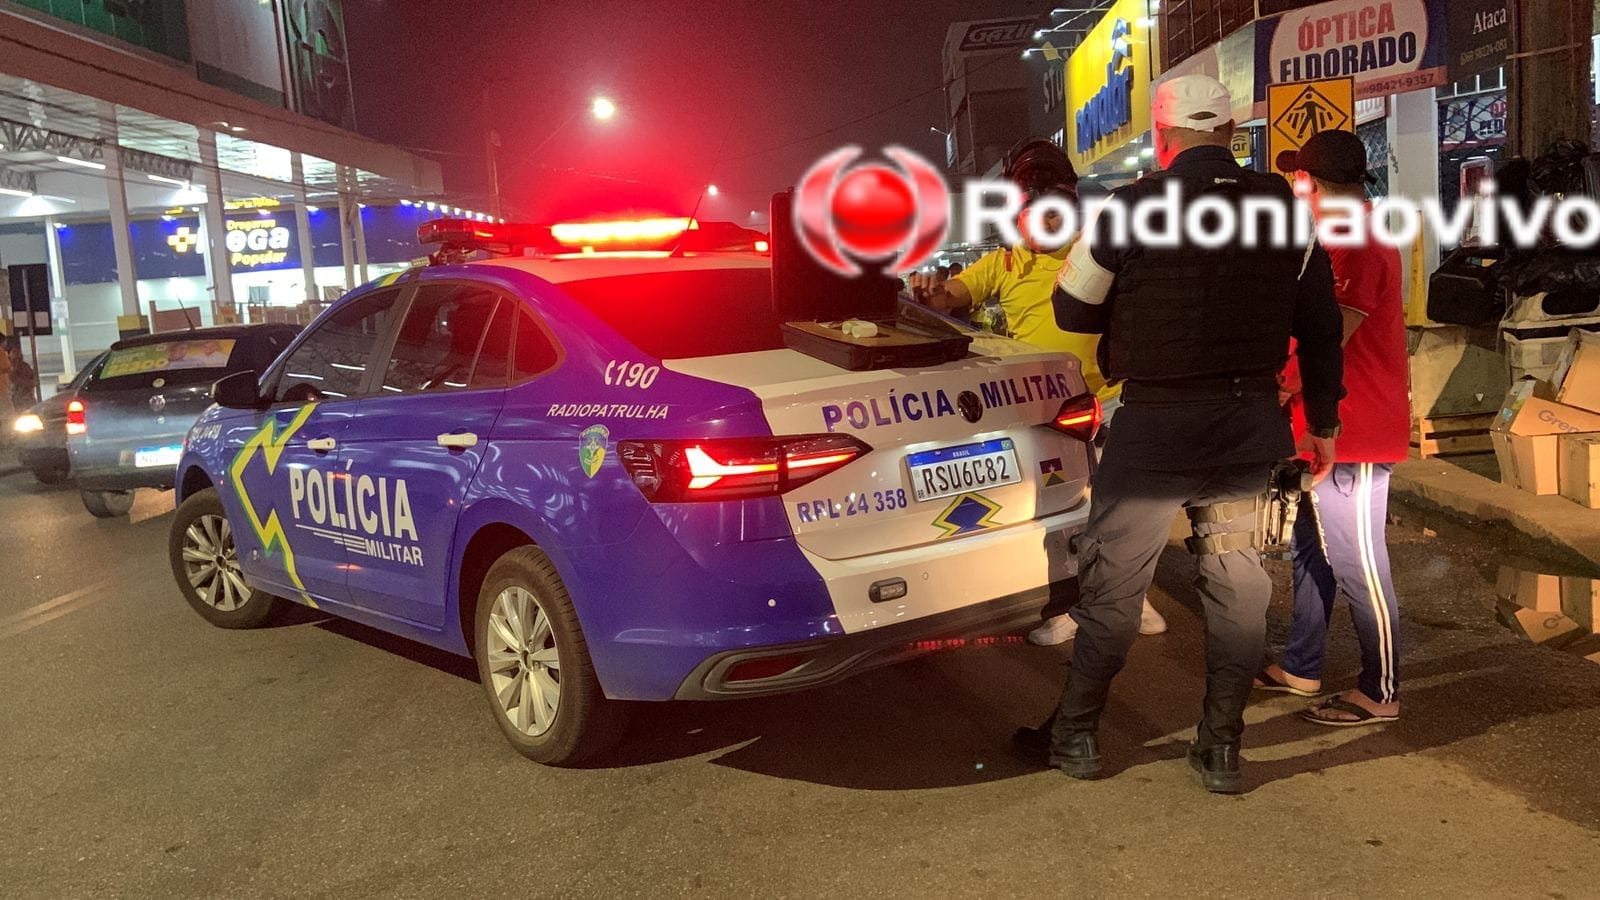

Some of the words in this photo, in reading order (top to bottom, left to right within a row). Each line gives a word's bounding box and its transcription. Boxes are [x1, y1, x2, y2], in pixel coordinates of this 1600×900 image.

[1297, 1, 1396, 52] ÓPTICA
[1472, 8, 1507, 35] Ataca
[615, 360, 660, 390] 190
[546, 404, 669, 420] RADIOPATRULHA
[821, 388, 956, 433] POLÍCIA
[979, 372, 1073, 410] MILITAR
[922, 455, 1011, 495] RSU6C82
[289, 458, 419, 542] POLÍCIA
[796, 498, 840, 523] RPL
[844, 493, 870, 516] 24
[873, 488, 908, 512] 358
[364, 538, 424, 567] MILITAR
